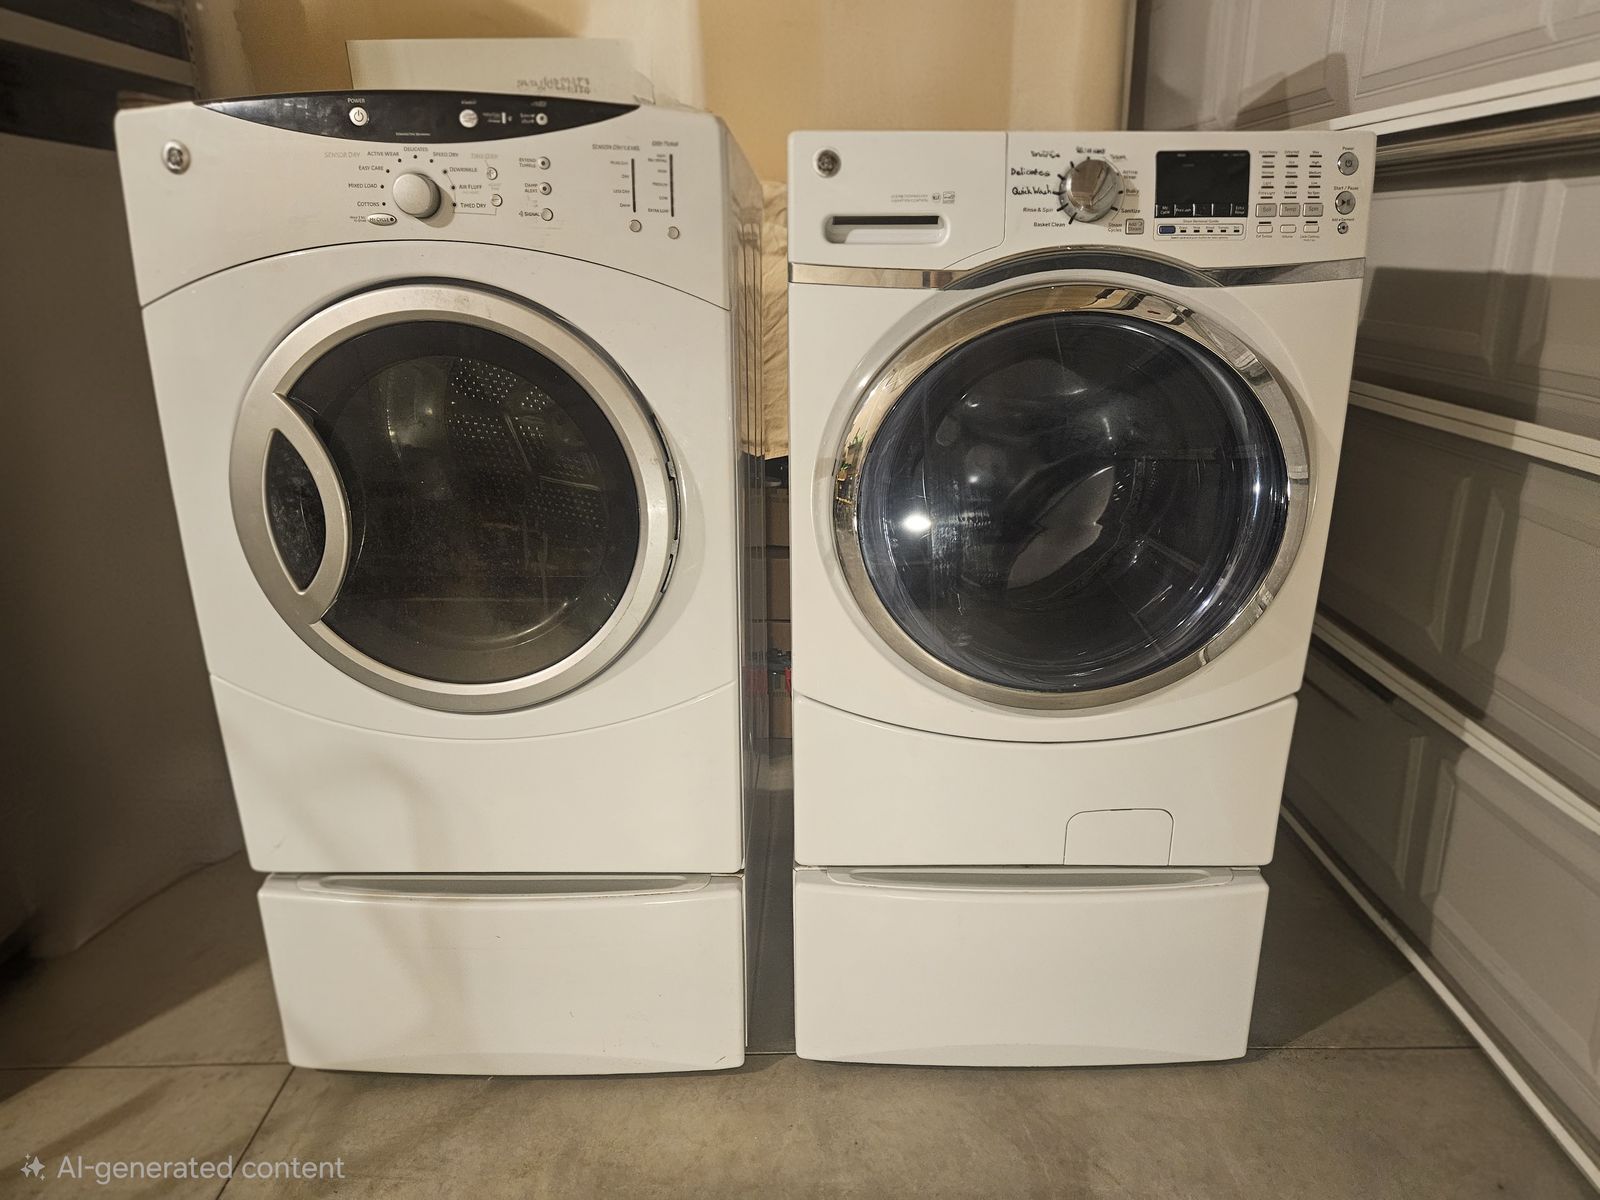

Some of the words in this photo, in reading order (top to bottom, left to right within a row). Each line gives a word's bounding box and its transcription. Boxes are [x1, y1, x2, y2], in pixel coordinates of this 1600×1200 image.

[1010, 167, 1051, 177] Delicates
[1012, 186, 1032, 195] Quick
[1032, 184, 1052, 195] Wash
